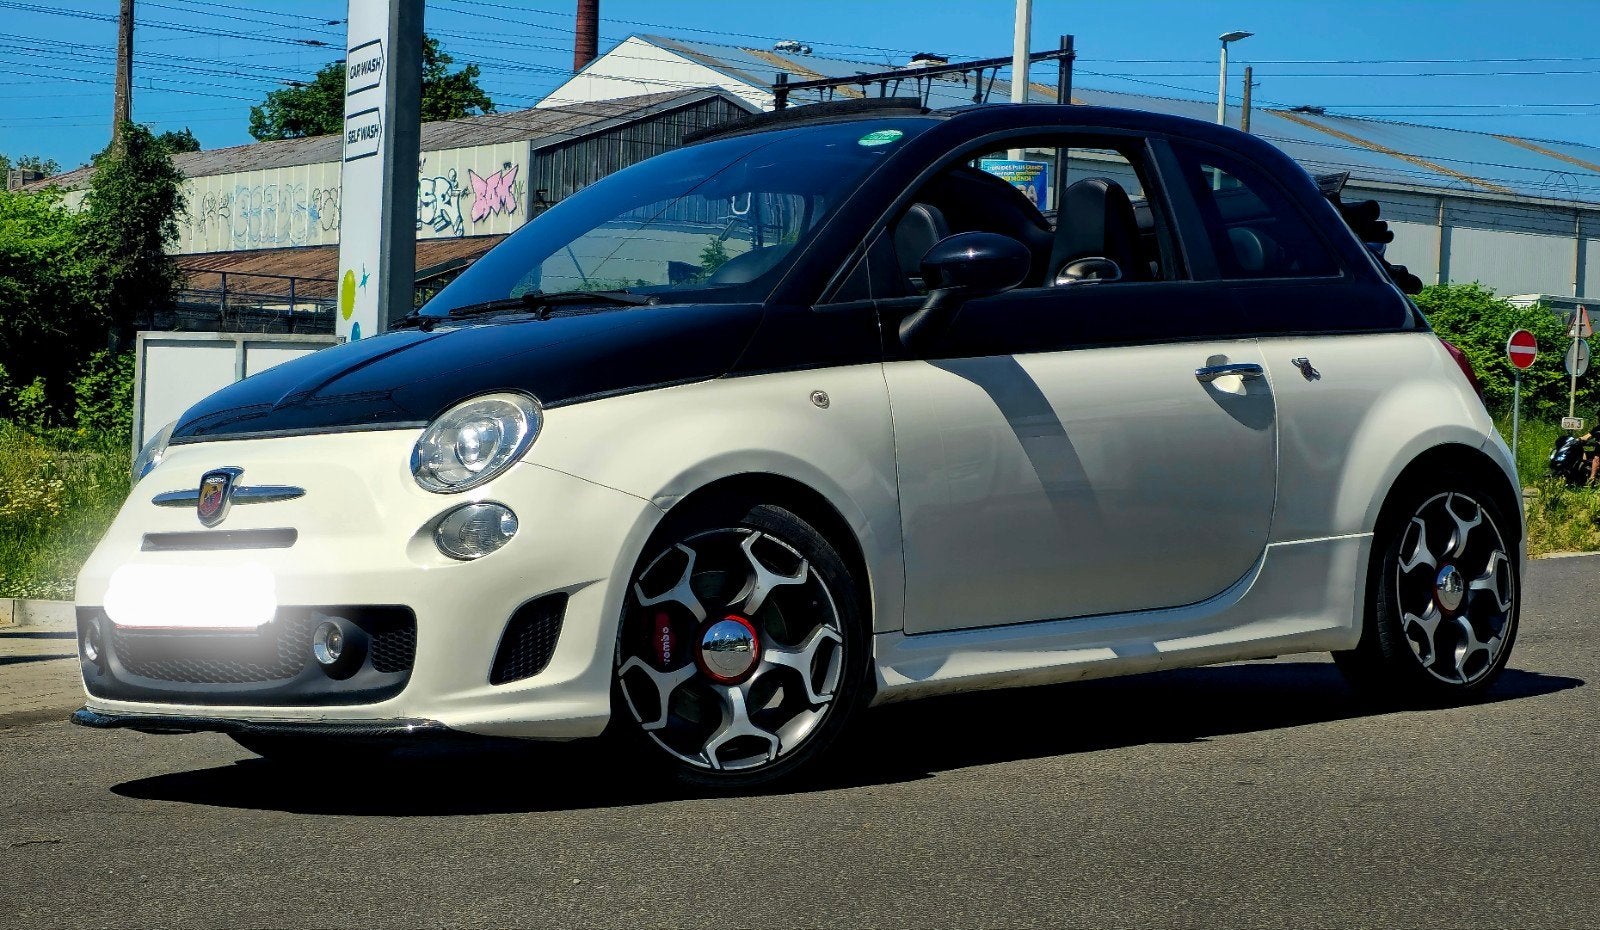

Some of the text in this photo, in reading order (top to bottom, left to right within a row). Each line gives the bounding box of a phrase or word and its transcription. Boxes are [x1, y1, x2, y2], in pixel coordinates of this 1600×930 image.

[350, 56, 381, 80] CAR WASH
[347, 123, 379, 145] SELF WASH
